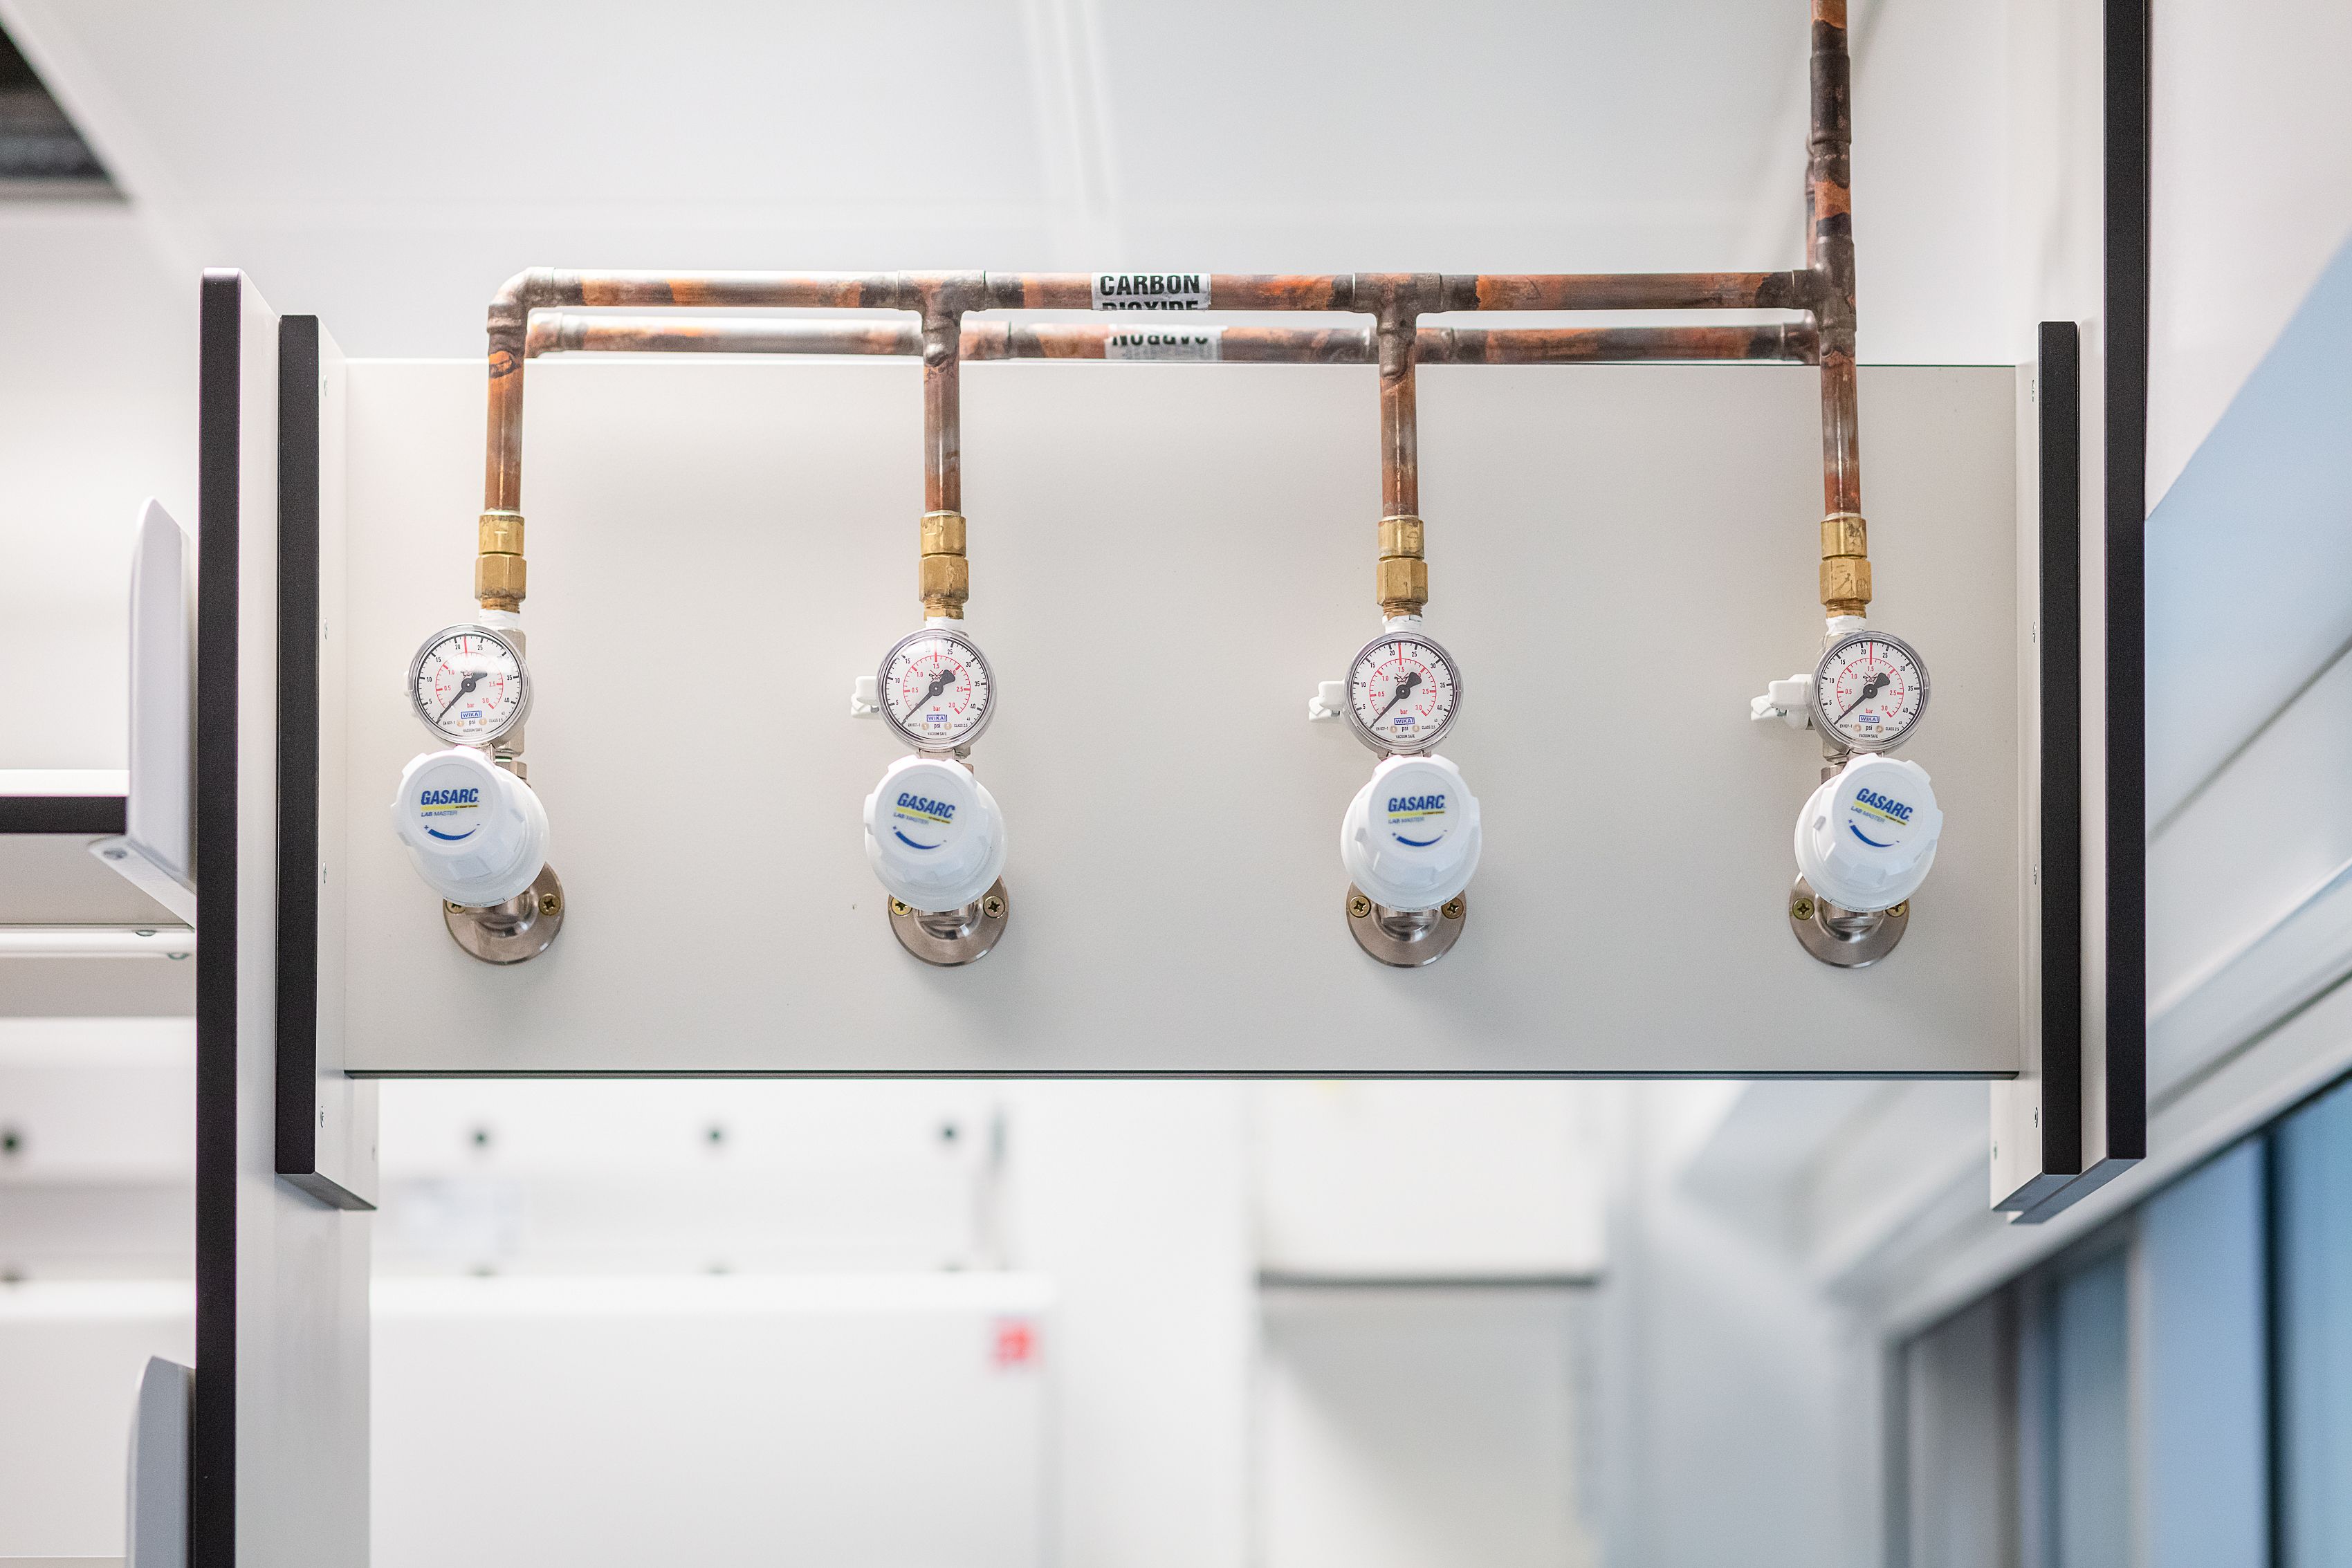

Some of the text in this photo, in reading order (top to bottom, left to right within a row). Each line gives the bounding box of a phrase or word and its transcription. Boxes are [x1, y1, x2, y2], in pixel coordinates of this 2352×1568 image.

[1100, 275, 1200, 296] CARBON
[421, 788, 479, 805] GASARC
[897, 793, 955, 818] GASARC
[1388, 795, 1444, 812] GASARC
[1857, 788, 1913, 820] GASARC
